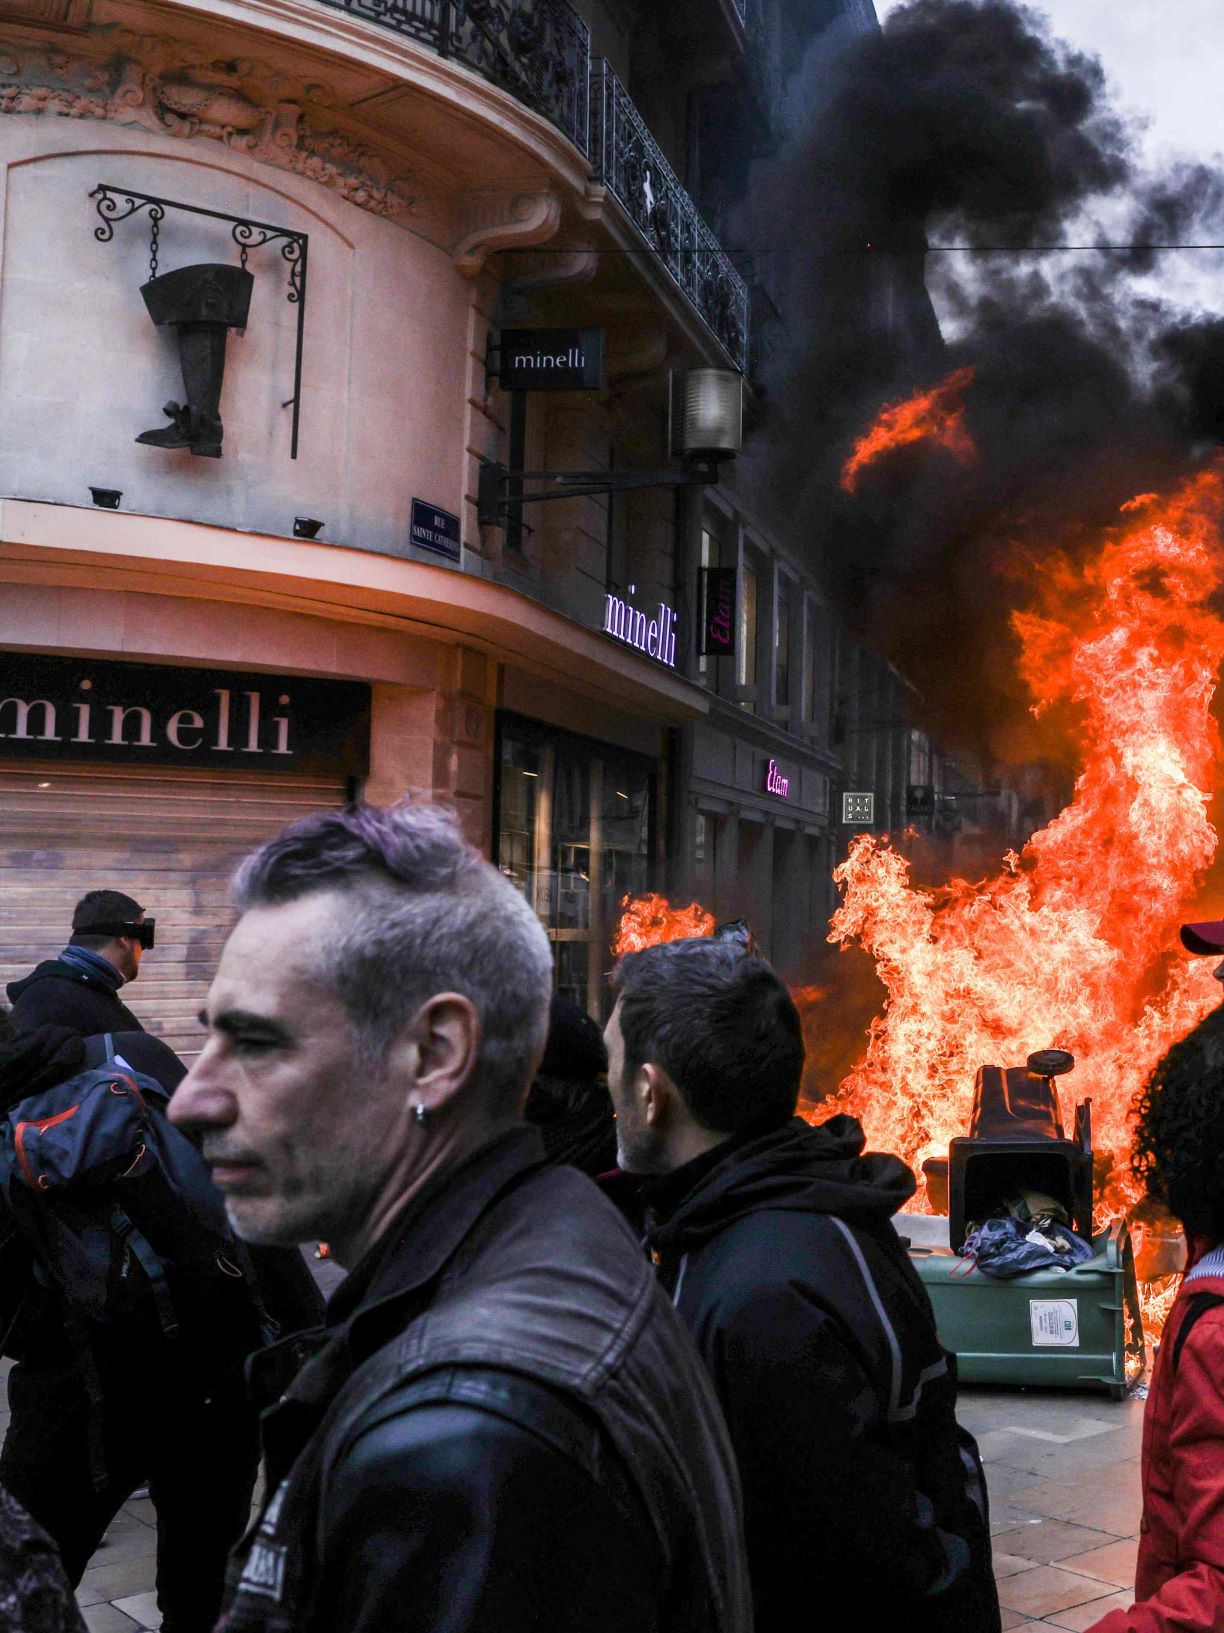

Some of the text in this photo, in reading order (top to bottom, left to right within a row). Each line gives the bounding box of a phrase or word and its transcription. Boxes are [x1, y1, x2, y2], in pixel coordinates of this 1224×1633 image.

[514, 348, 585, 368] minelli
[604, 584, 678, 668] minelli
[0, 679, 294, 755] minelli
[767, 759, 788, 797] Etam
